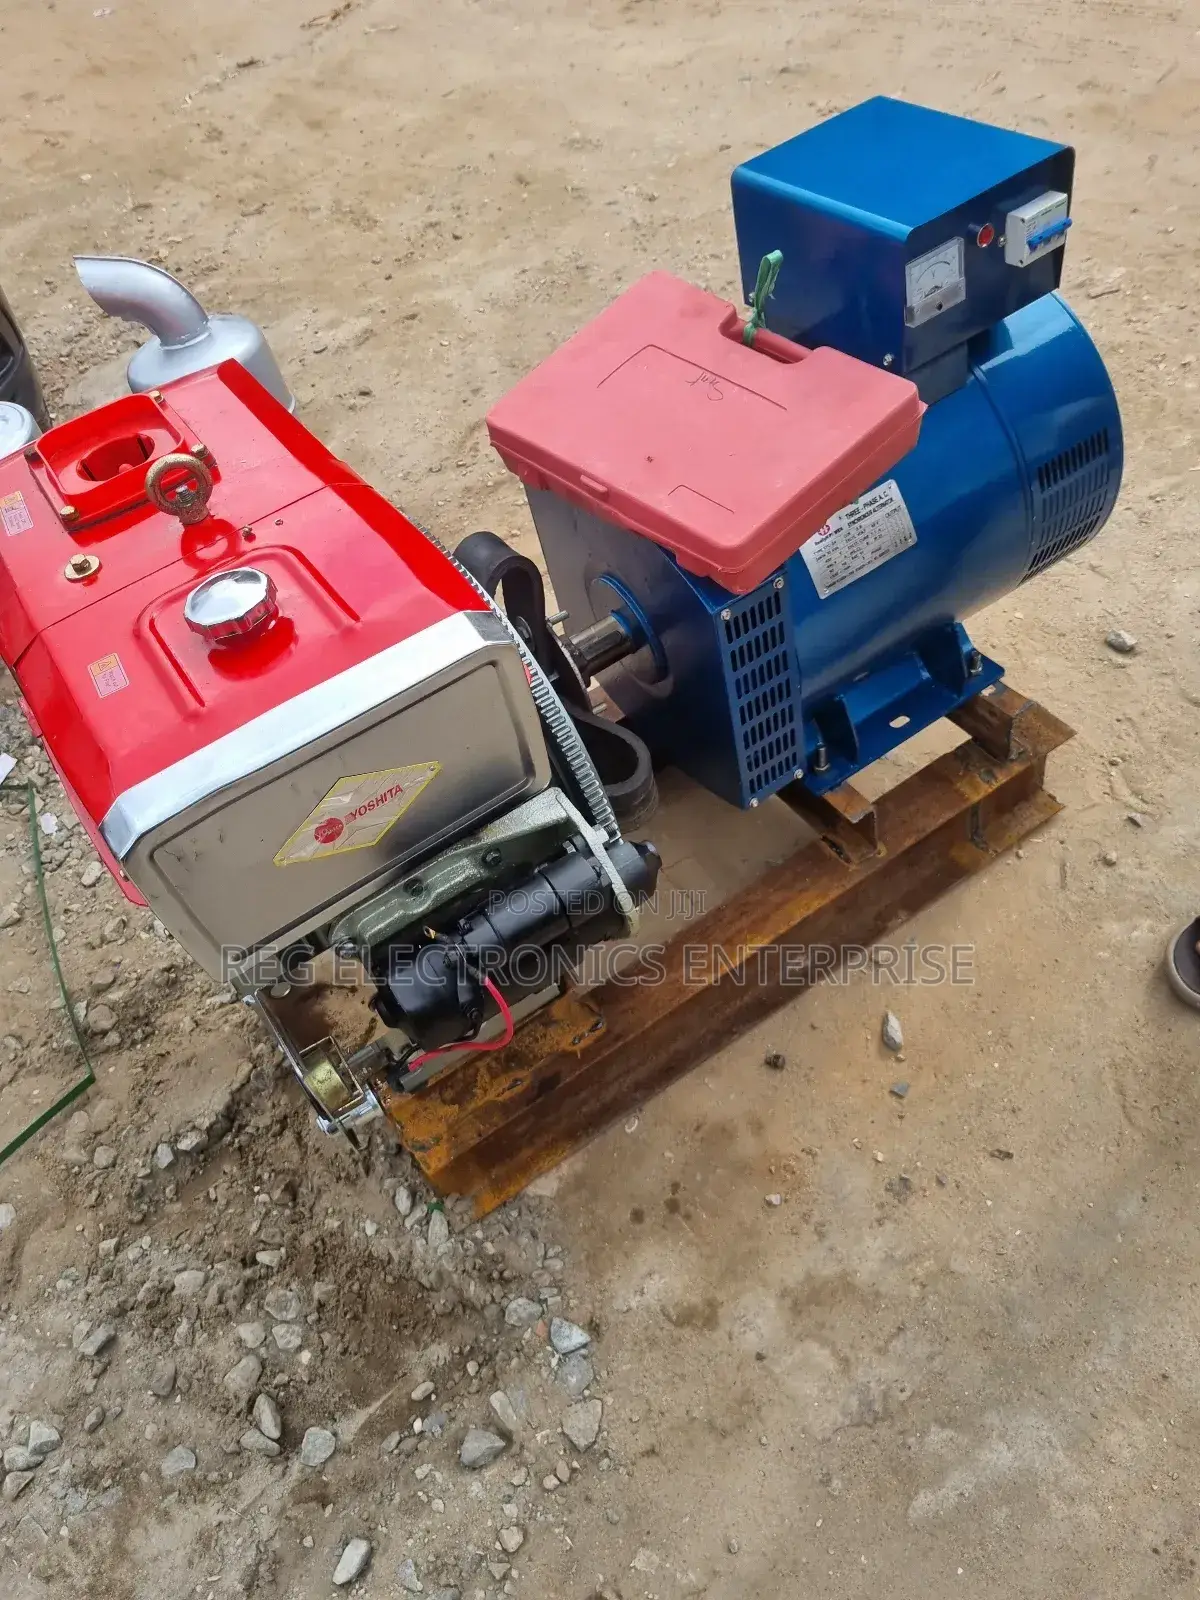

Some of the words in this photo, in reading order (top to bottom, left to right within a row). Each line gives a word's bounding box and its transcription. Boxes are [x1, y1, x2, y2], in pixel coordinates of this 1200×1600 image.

[845, 507, 860, 519] THREE
[863, 497, 880, 510] PHASE
[350, 784, 404, 820] YOSHITA
